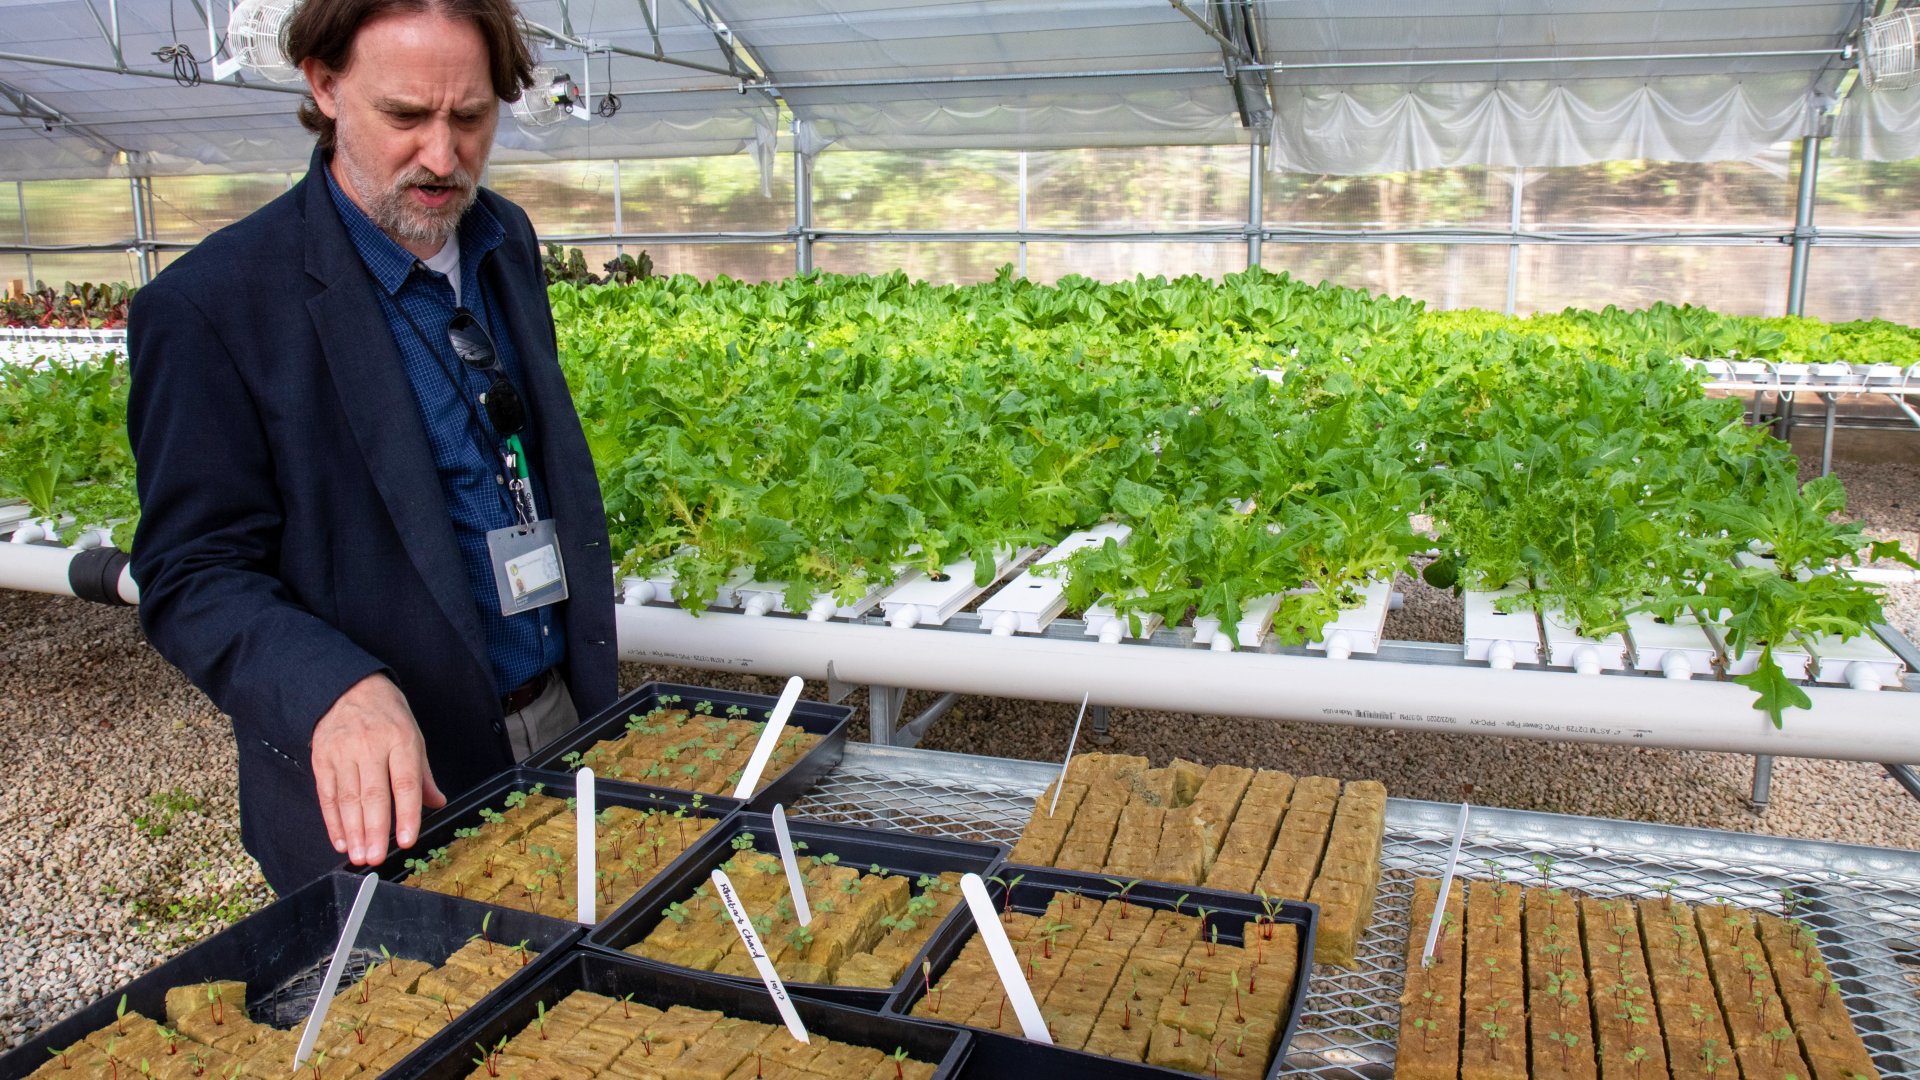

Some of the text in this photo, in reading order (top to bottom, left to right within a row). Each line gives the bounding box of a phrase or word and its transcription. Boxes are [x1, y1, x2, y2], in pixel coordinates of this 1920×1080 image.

[1469, 718, 1496, 727] PPC-KY
[1505, 720, 1521, 728] Pipe
[1522, 721, 1543, 730] Sewer
[1544, 723, 1560, 731] PVC
[1566, 725, 1588, 733] D2729
[720, 883, 745, 925] Rhubarb
[742, 928, 766, 959] Chard
